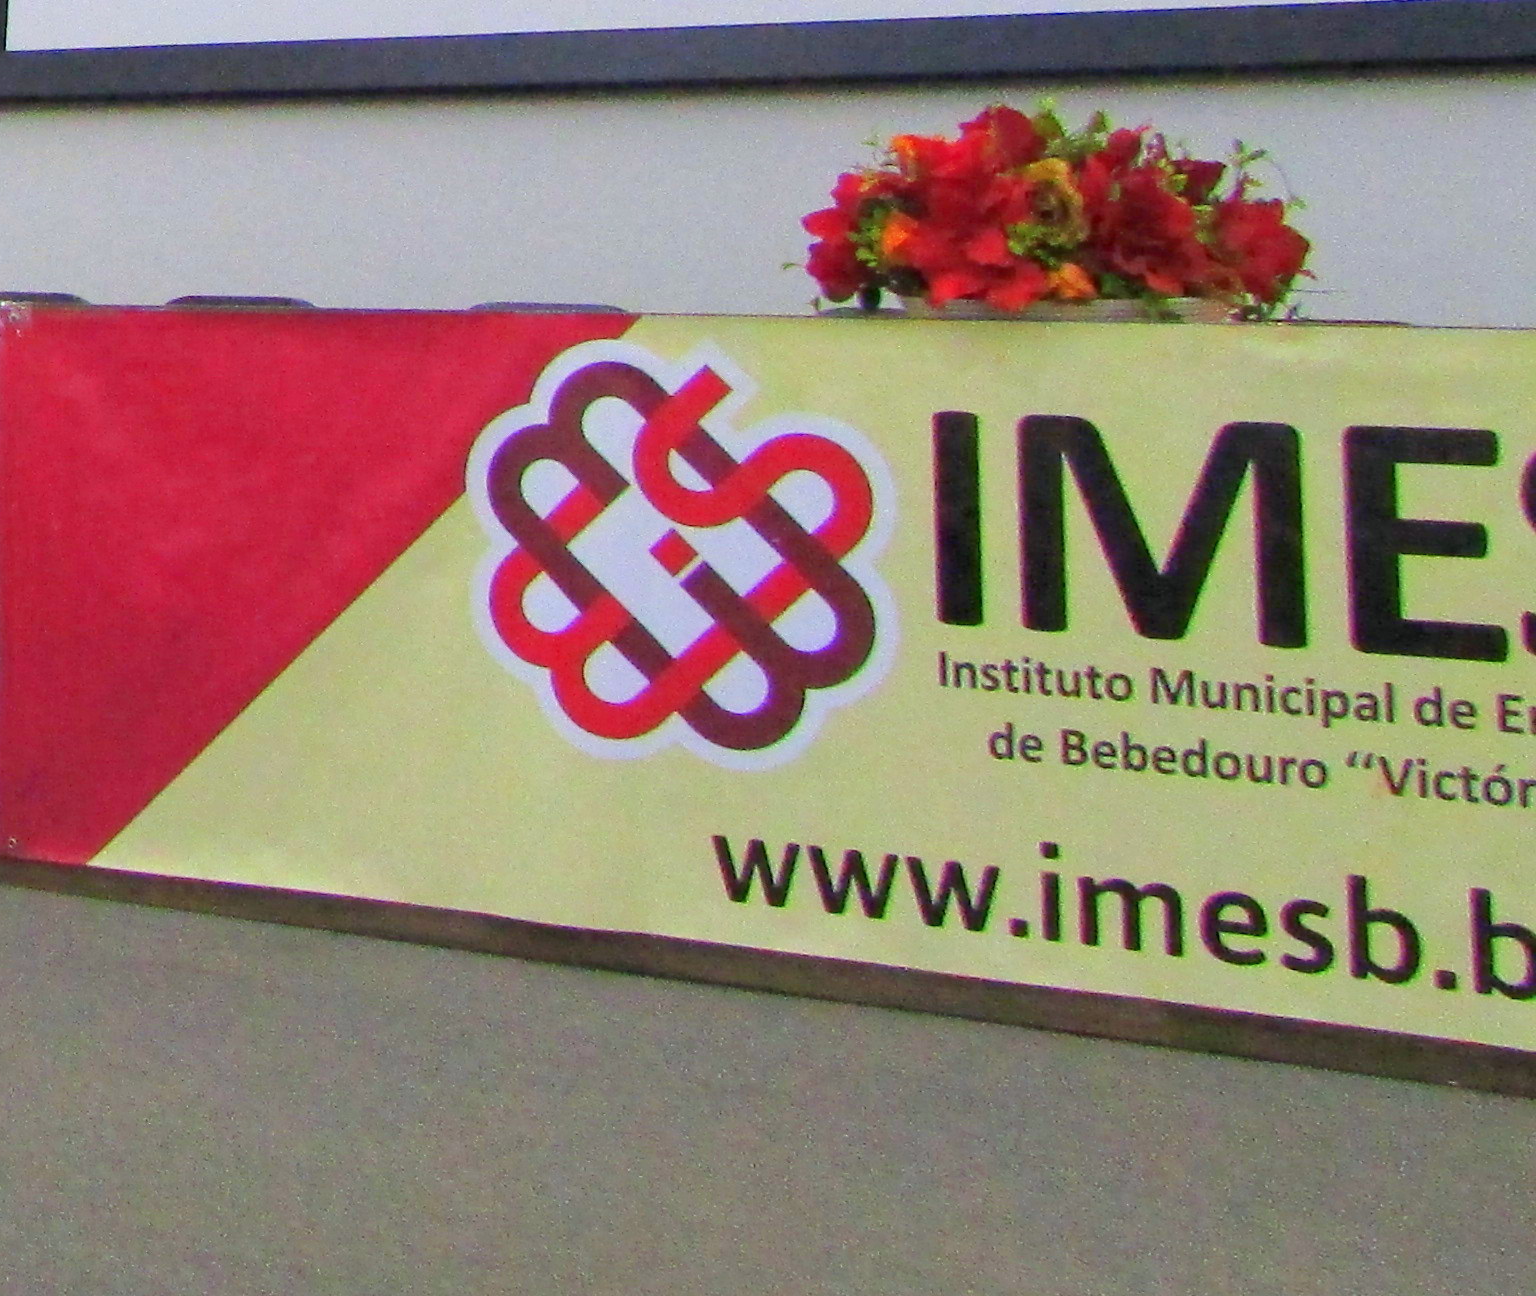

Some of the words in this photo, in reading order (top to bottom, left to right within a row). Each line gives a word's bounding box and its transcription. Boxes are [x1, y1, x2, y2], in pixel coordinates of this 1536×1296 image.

[931, 410, 1536, 661] IME
[937, 651, 1133, 702] Instituto
[1150, 667, 1395, 728] Municipal
[1413, 686, 1477, 729] de
[1496, 694, 1536, 735] E
[990, 724, 1043, 763] de
[1060, 730, 1328, 789] Bebedouro
